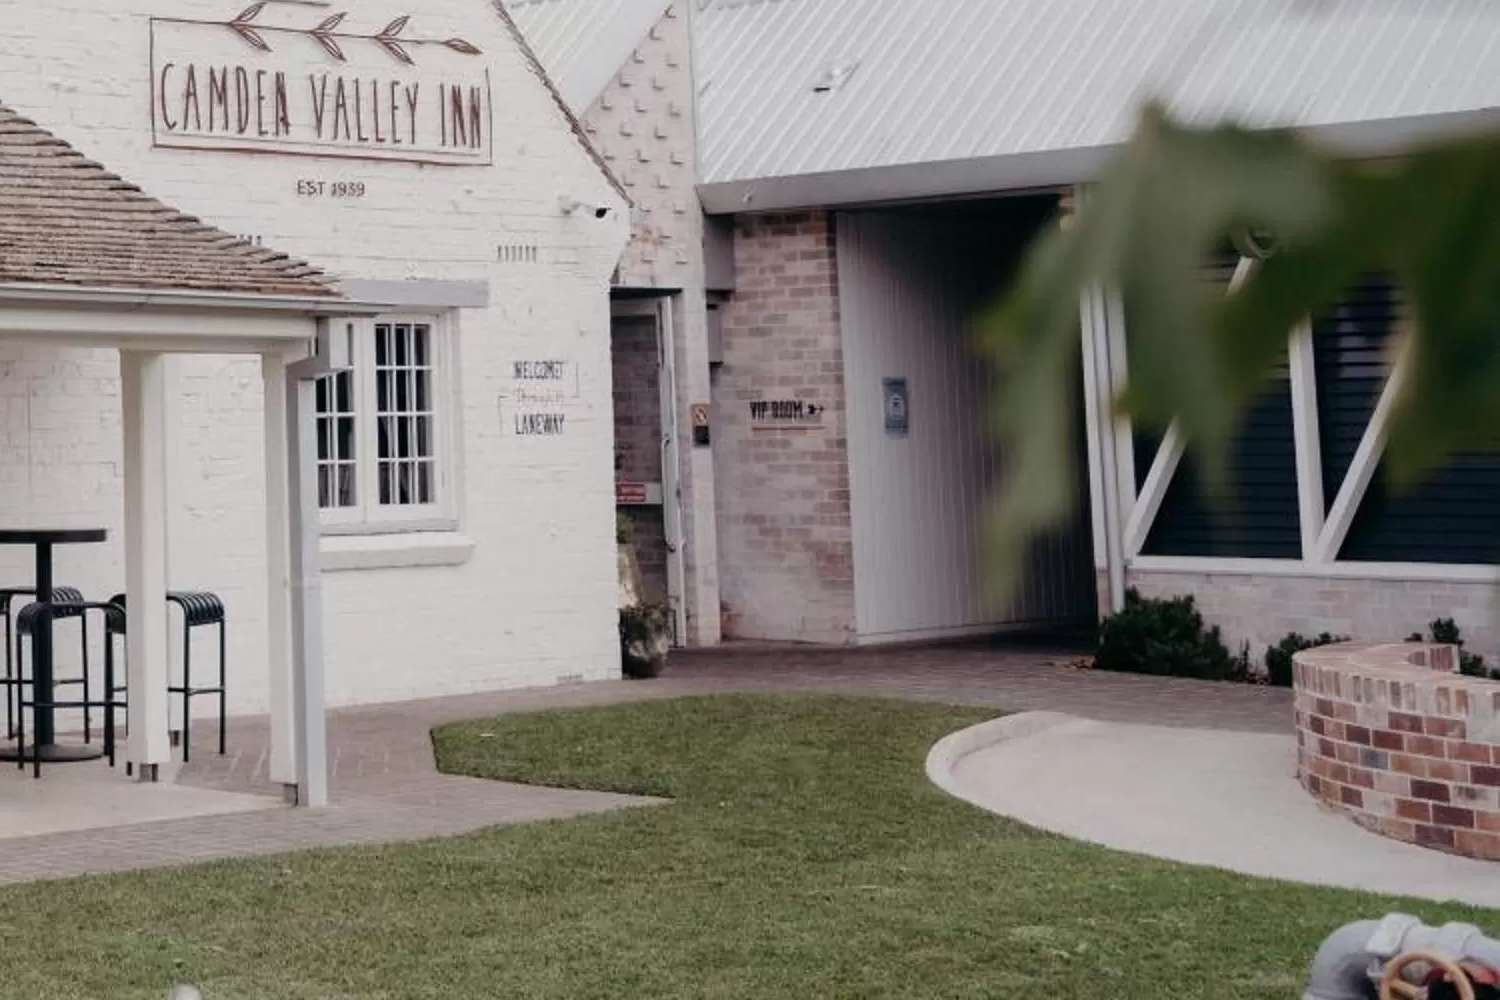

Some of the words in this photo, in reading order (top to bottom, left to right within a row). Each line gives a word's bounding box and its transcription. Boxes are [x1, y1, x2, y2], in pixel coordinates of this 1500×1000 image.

[161, 63, 291, 137] CAMDEN
[309, 73, 419, 145] VALLEY
[439, 82, 481, 149] INN
[297, 179, 325, 196] EST
[331, 180, 365, 197] 1939
[749, 400, 767, 420] VIP
[771, 400, 803, 420] ROOM
[514, 413, 565, 435] LANEWAY
